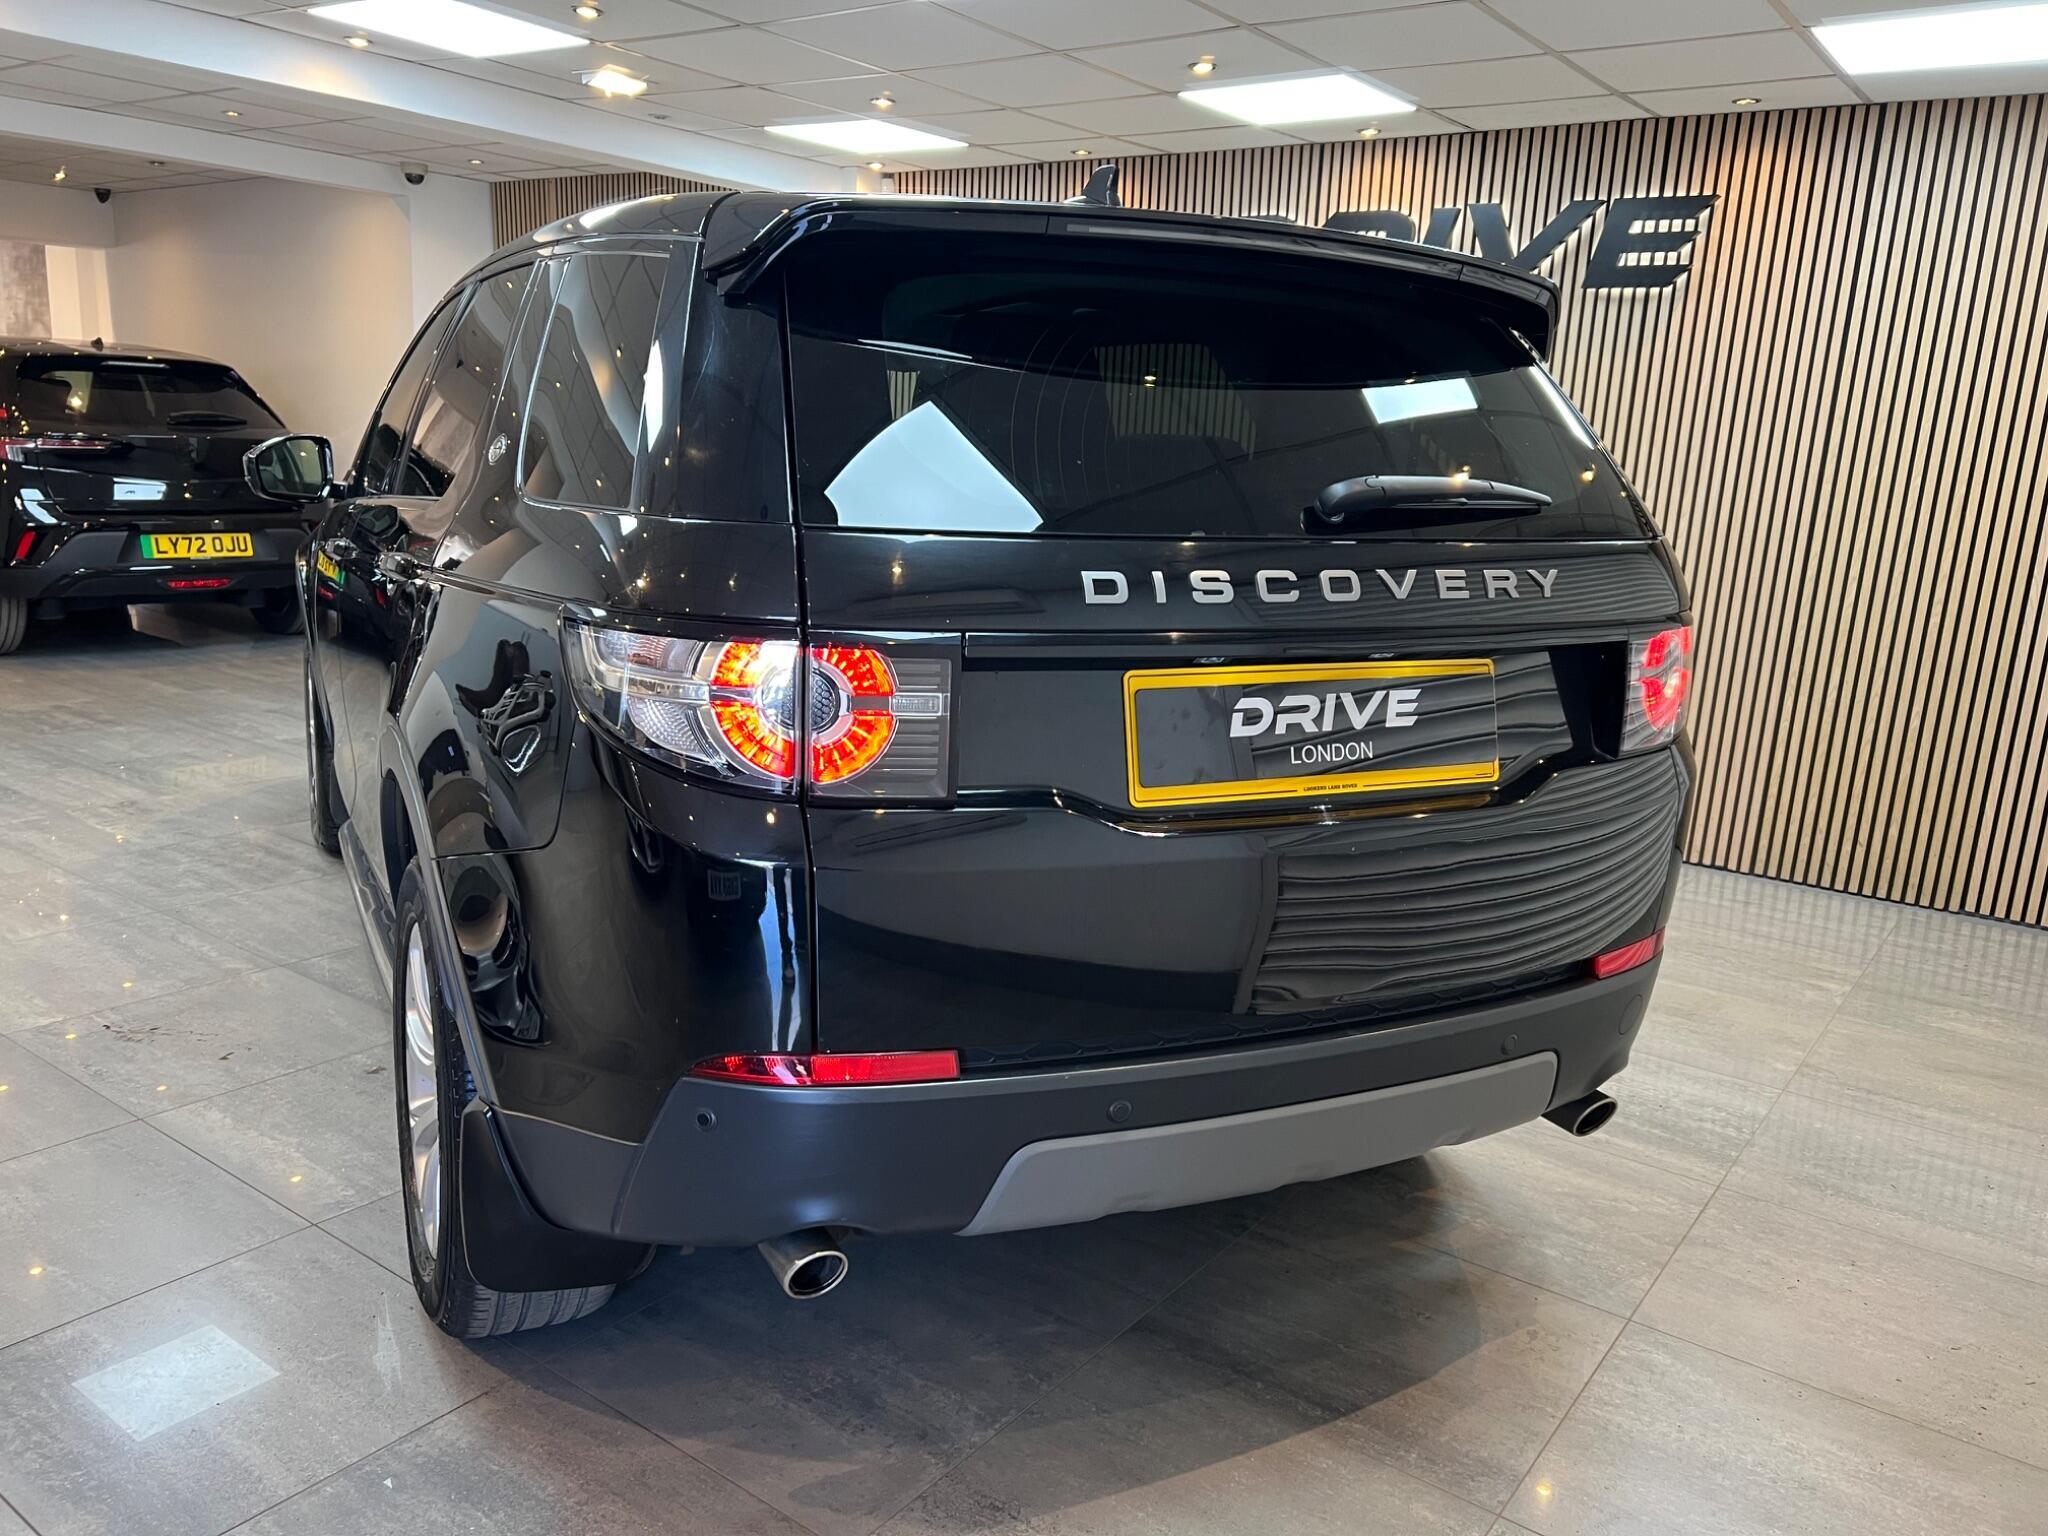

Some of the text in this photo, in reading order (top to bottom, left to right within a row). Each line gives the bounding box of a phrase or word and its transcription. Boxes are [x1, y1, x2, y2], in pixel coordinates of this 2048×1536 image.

[154, 536, 207, 554] LY72
[1080, 567, 1560, 604] DISCOVERY
[1229, 688, 1422, 737] DRIVE
[1290, 741, 1374, 765] LONDON
